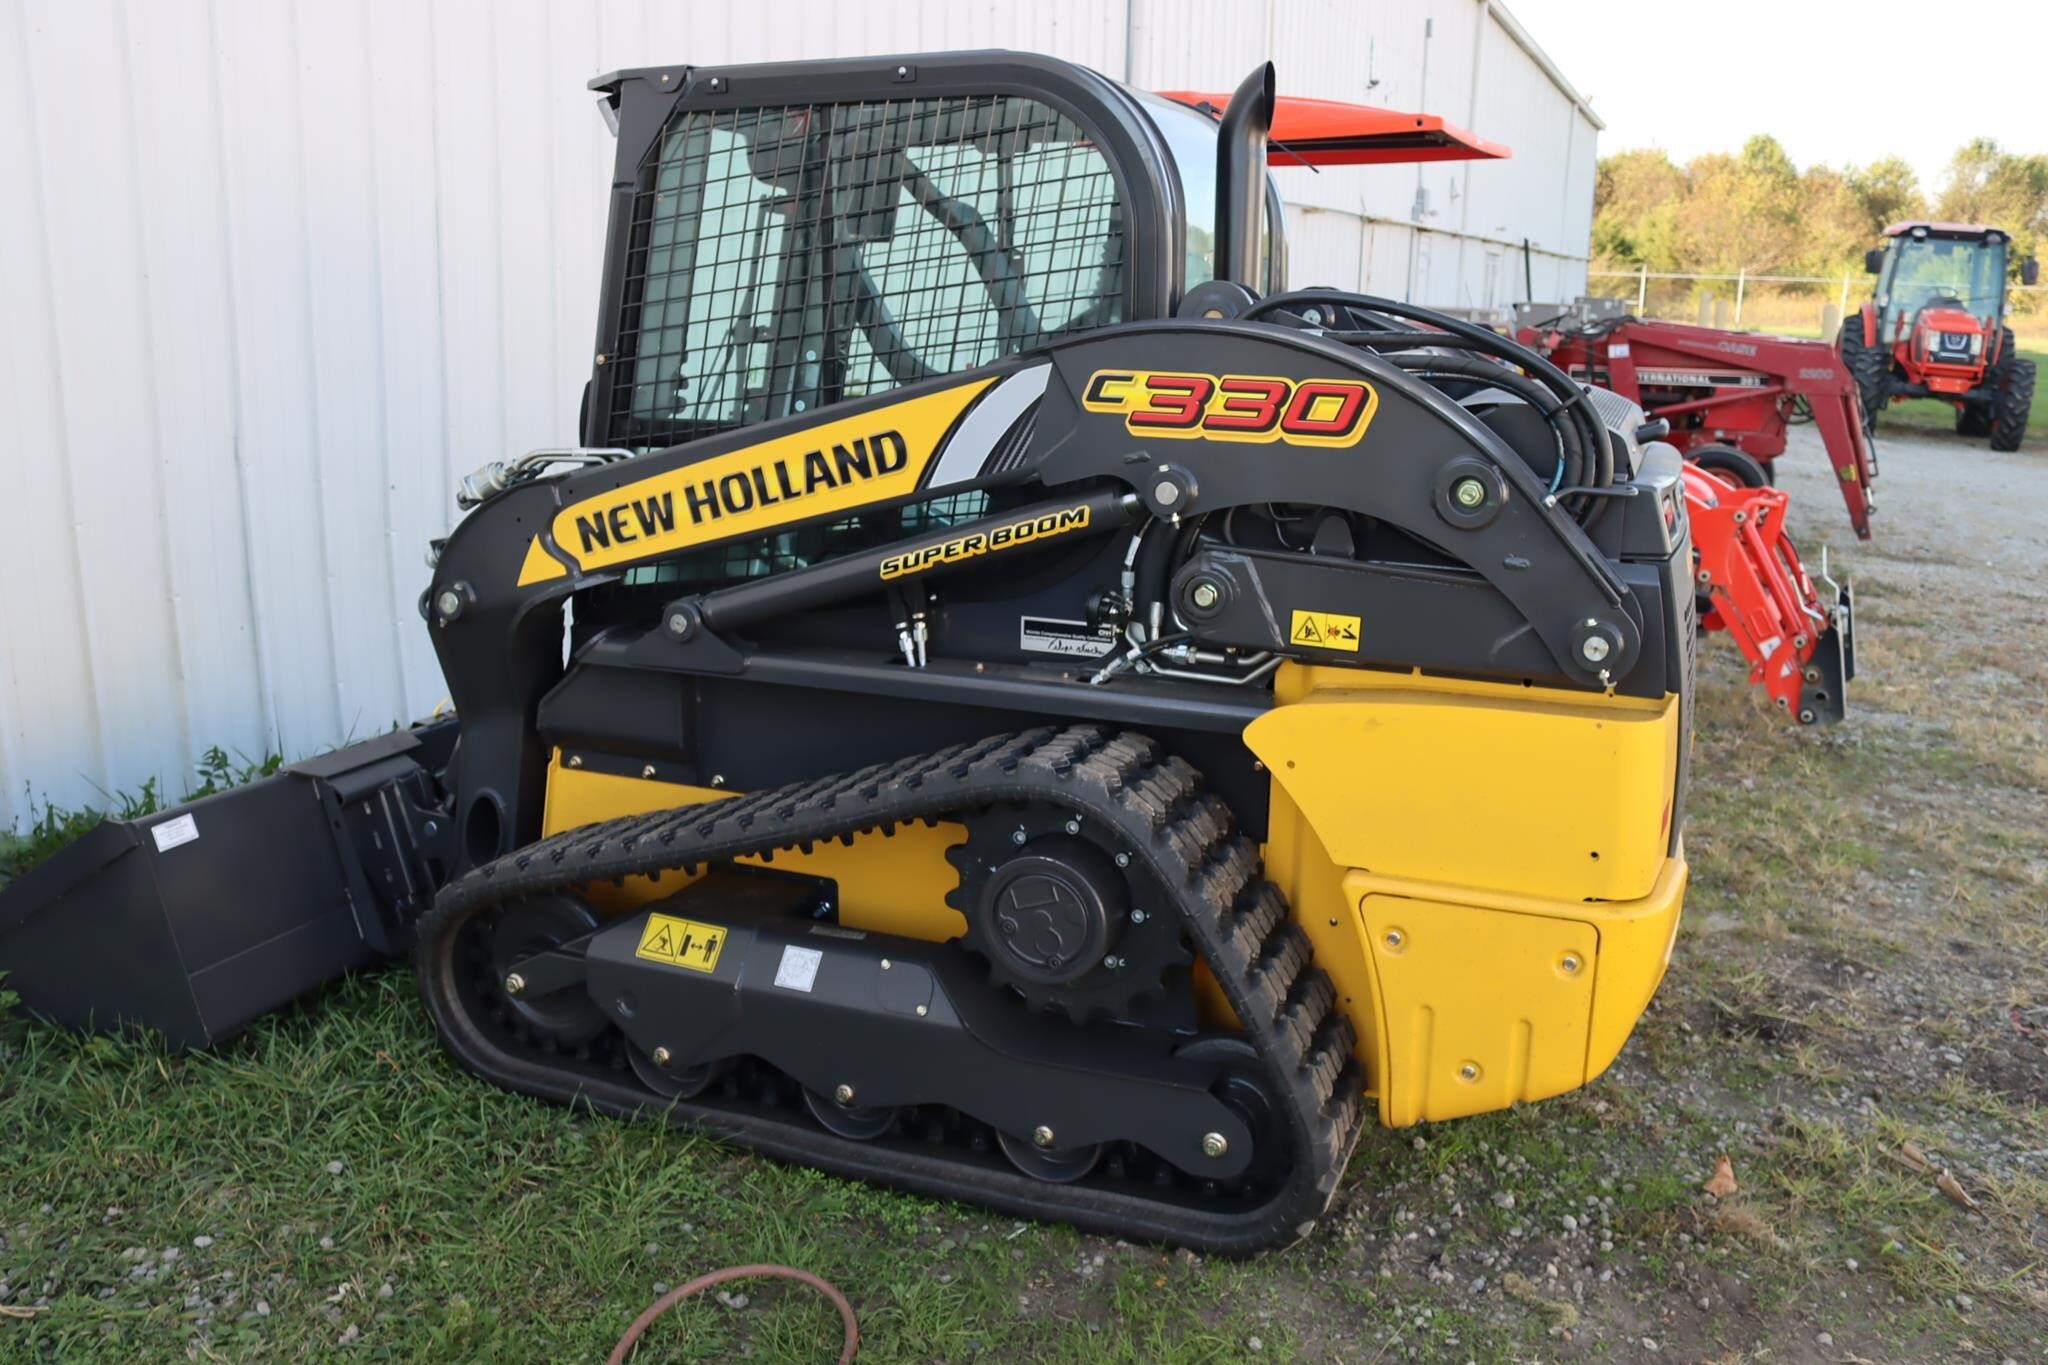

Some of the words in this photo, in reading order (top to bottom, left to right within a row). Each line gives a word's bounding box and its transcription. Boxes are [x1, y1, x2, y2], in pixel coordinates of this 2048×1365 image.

[1083, 371, 1375, 443] C330
[1637, 372, 1711, 385] TERNATIONAL
[574, 491, 676, 553] NEW
[684, 430, 909, 525] HOLLAND
[881, 534, 986, 578] SUPER
[991, 506, 1089, 549] BOOM
